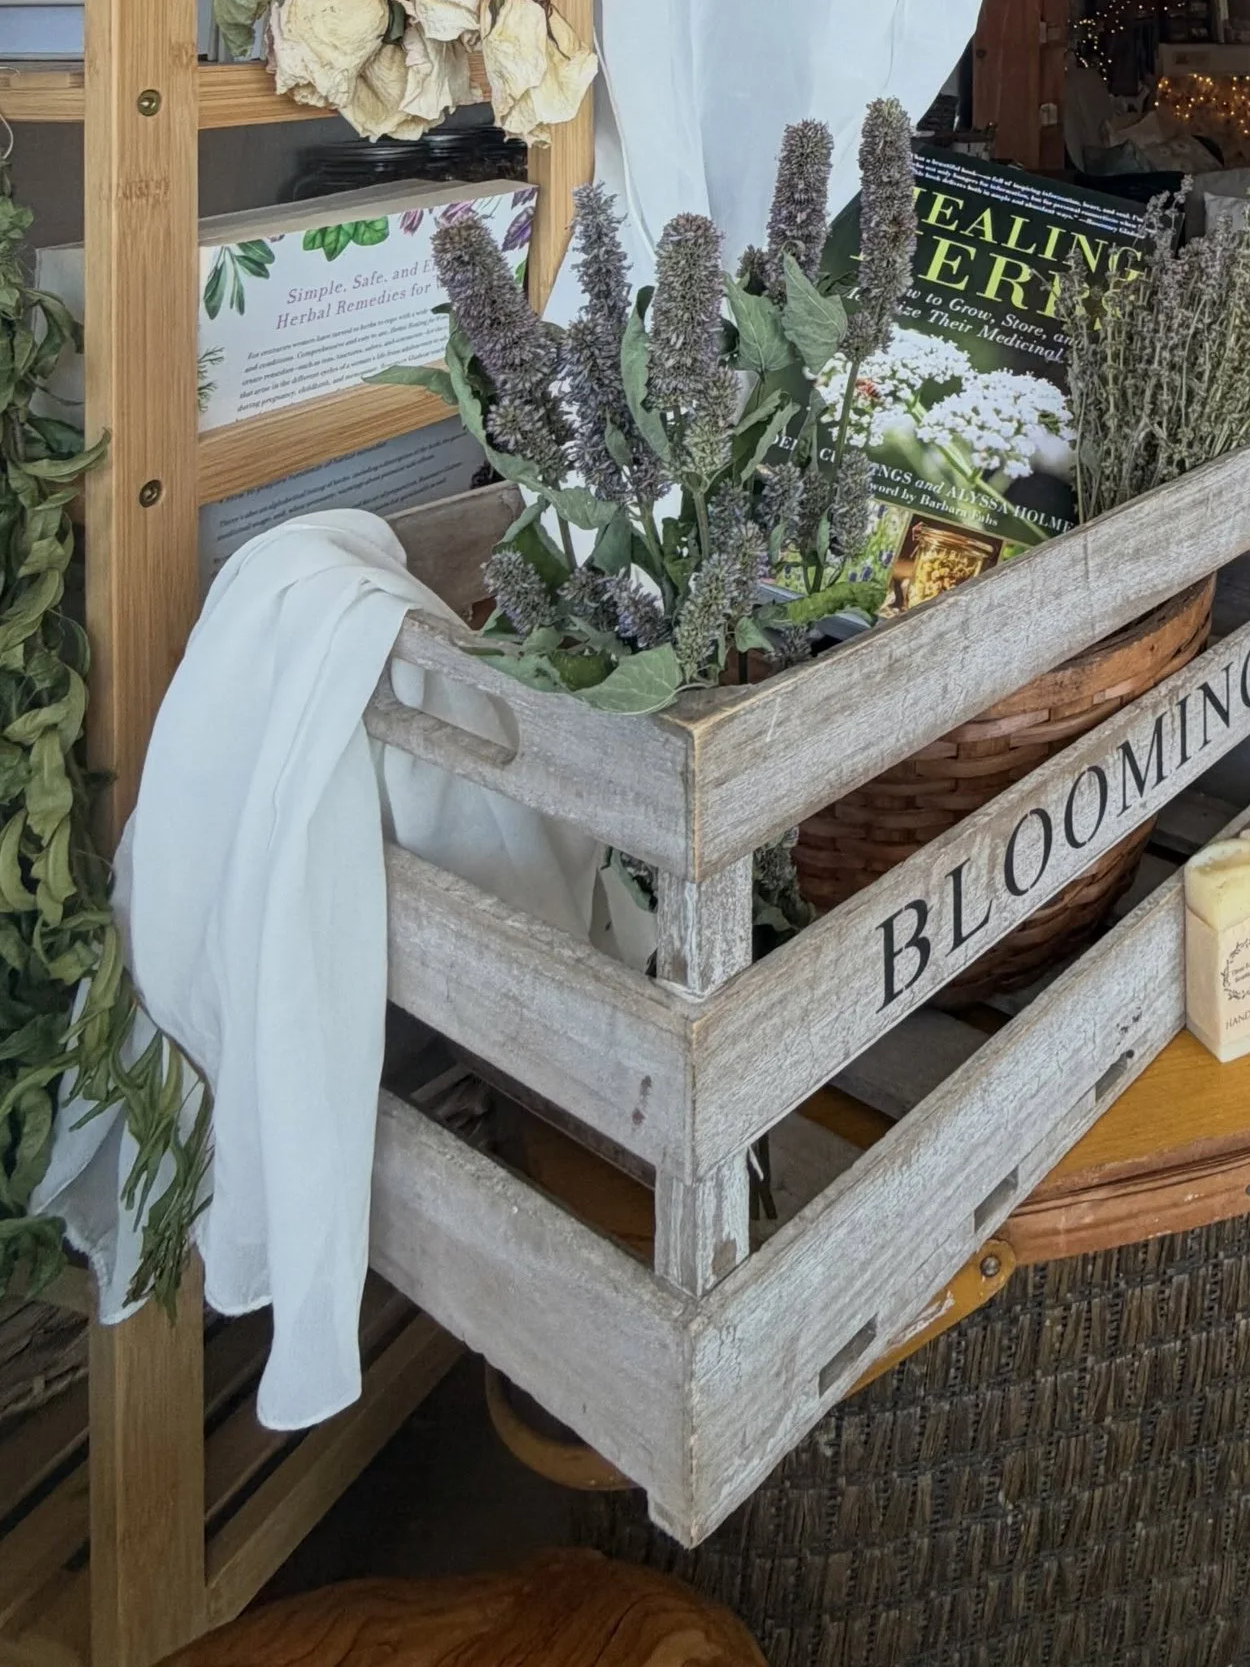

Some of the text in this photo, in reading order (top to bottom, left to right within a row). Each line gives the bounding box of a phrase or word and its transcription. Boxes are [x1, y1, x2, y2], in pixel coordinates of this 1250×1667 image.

[392, 261, 417, 280] and
[276, 279, 431, 330] Herbal Remedies for
[926, 292, 943, 306] to
[950, 298, 996, 324] Grow,
[1001, 314, 1047, 341] Store,
[930, 308, 973, 334] Their
[977, 324, 1064, 364] Medicinal
[901, 488, 914, 504] by
[920, 495, 968, 518] Barbara
[915, 476, 1074, 534] and ALYSSA HOLME
